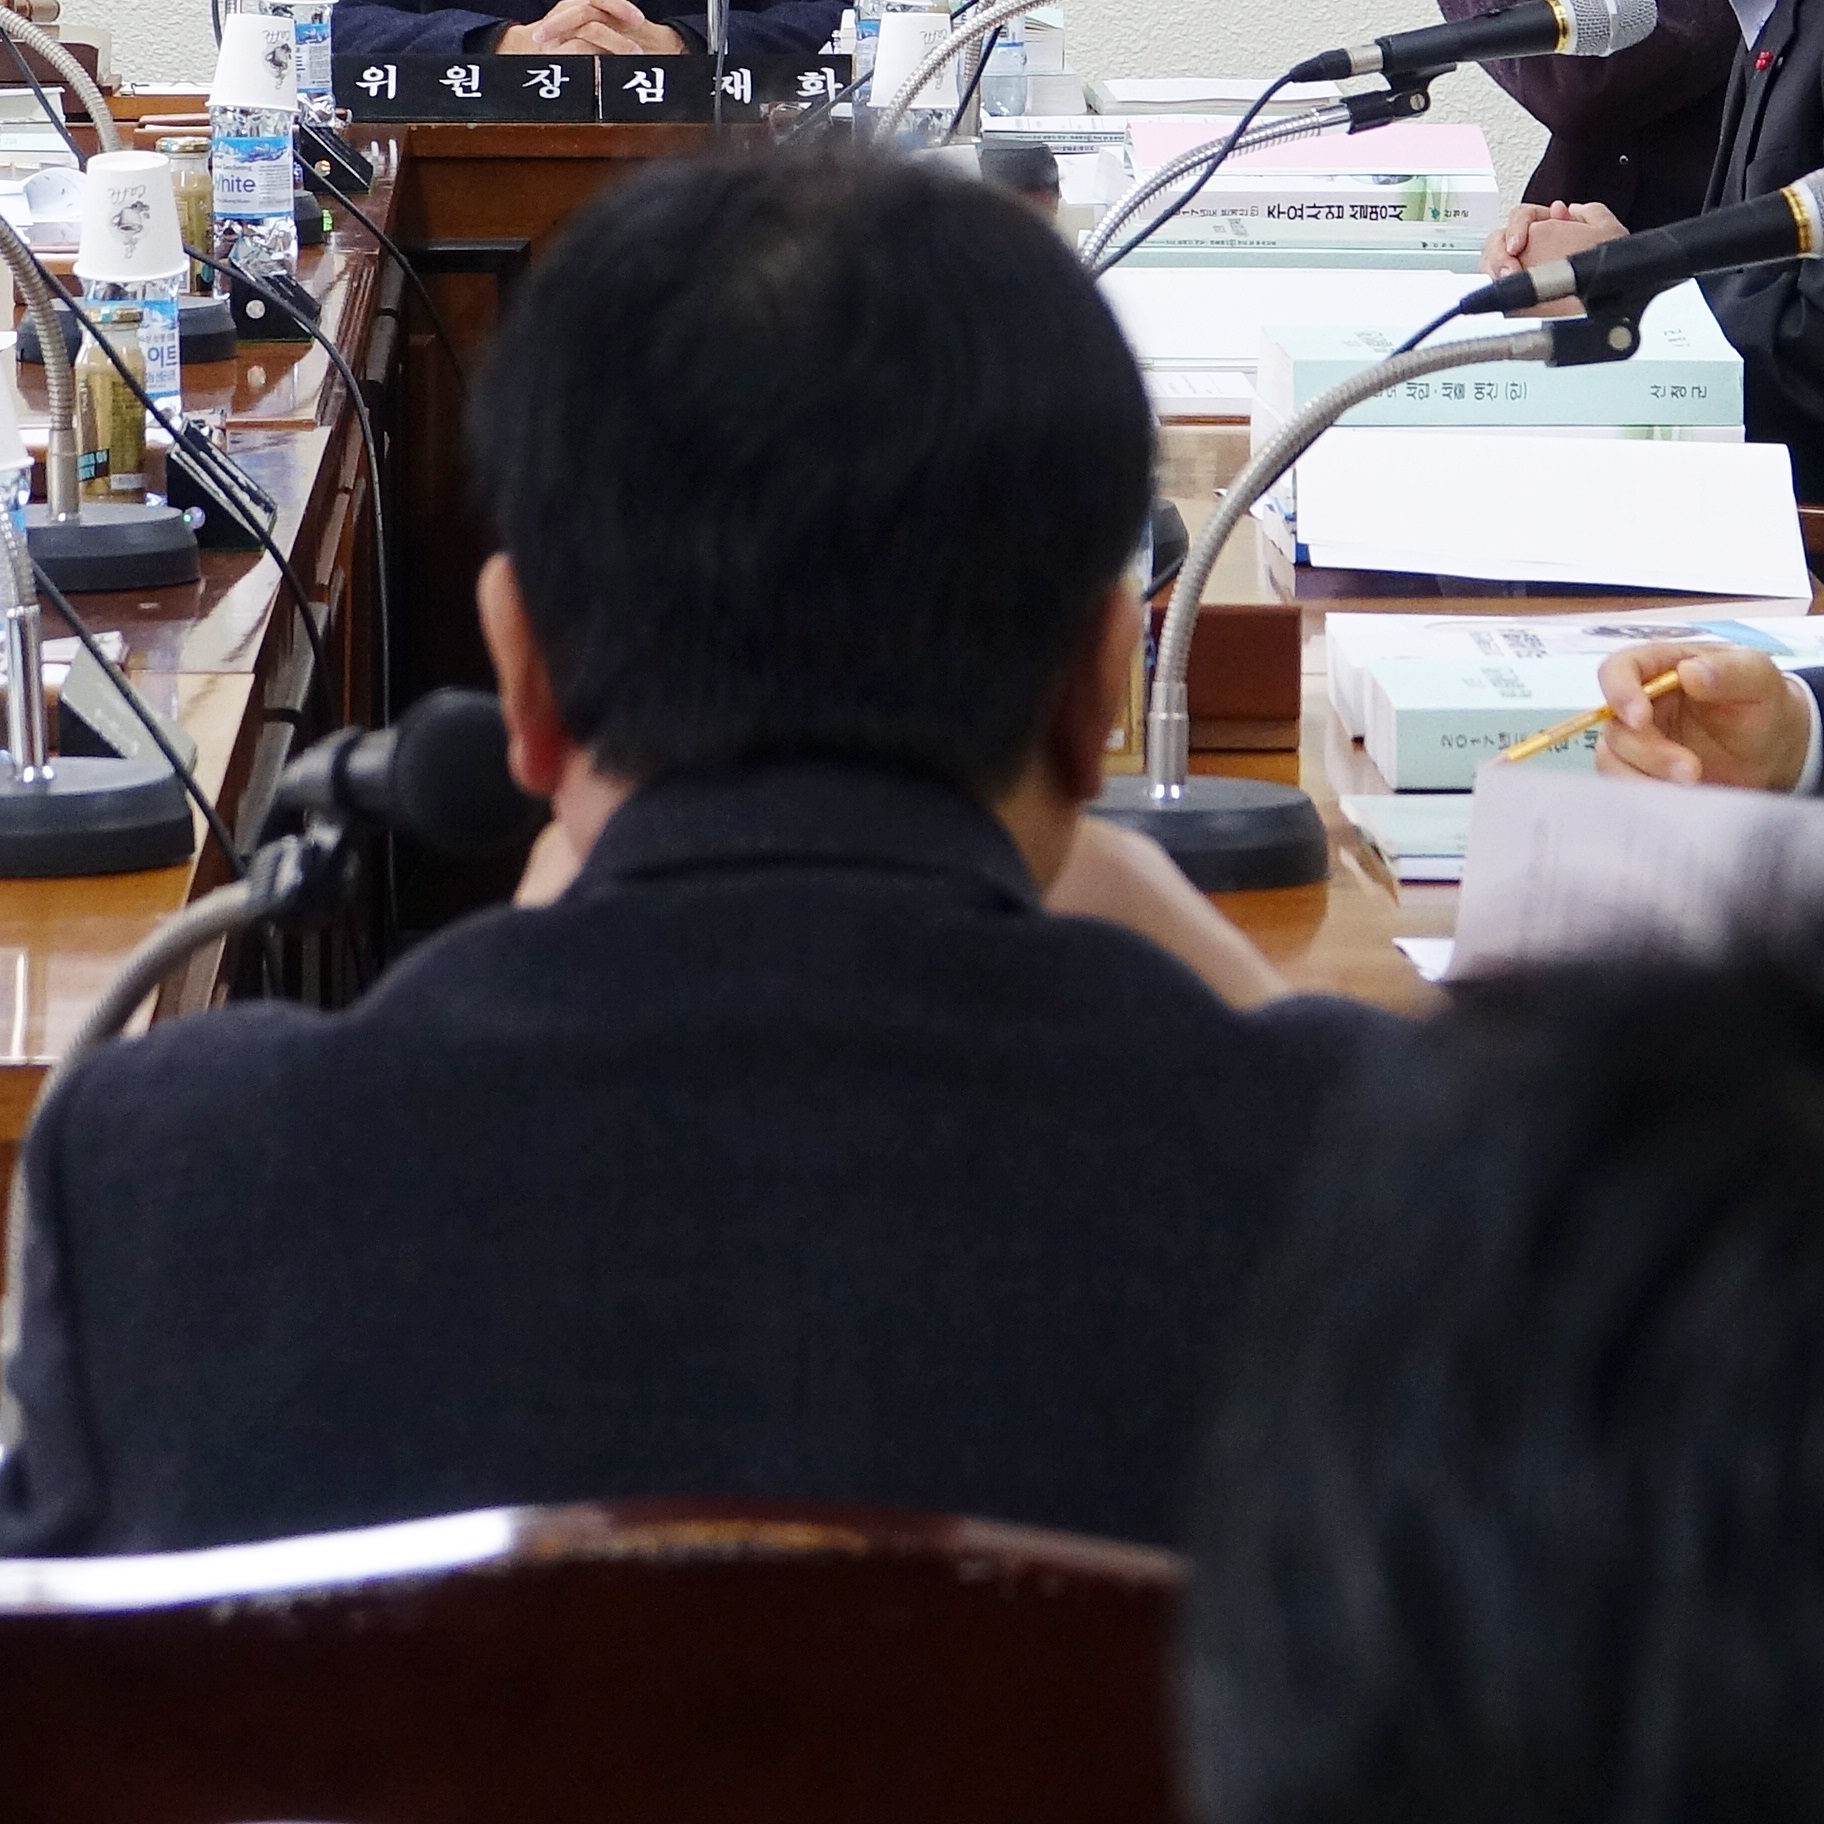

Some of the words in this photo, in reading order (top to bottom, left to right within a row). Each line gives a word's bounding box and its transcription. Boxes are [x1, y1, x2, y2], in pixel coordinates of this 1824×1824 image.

[355, 64, 570, 100] 위원장
[621, 67, 845, 104] 심재화
[1267, 203, 1345, 220] 주요사업
[1349, 204, 1408, 221] 설명서
